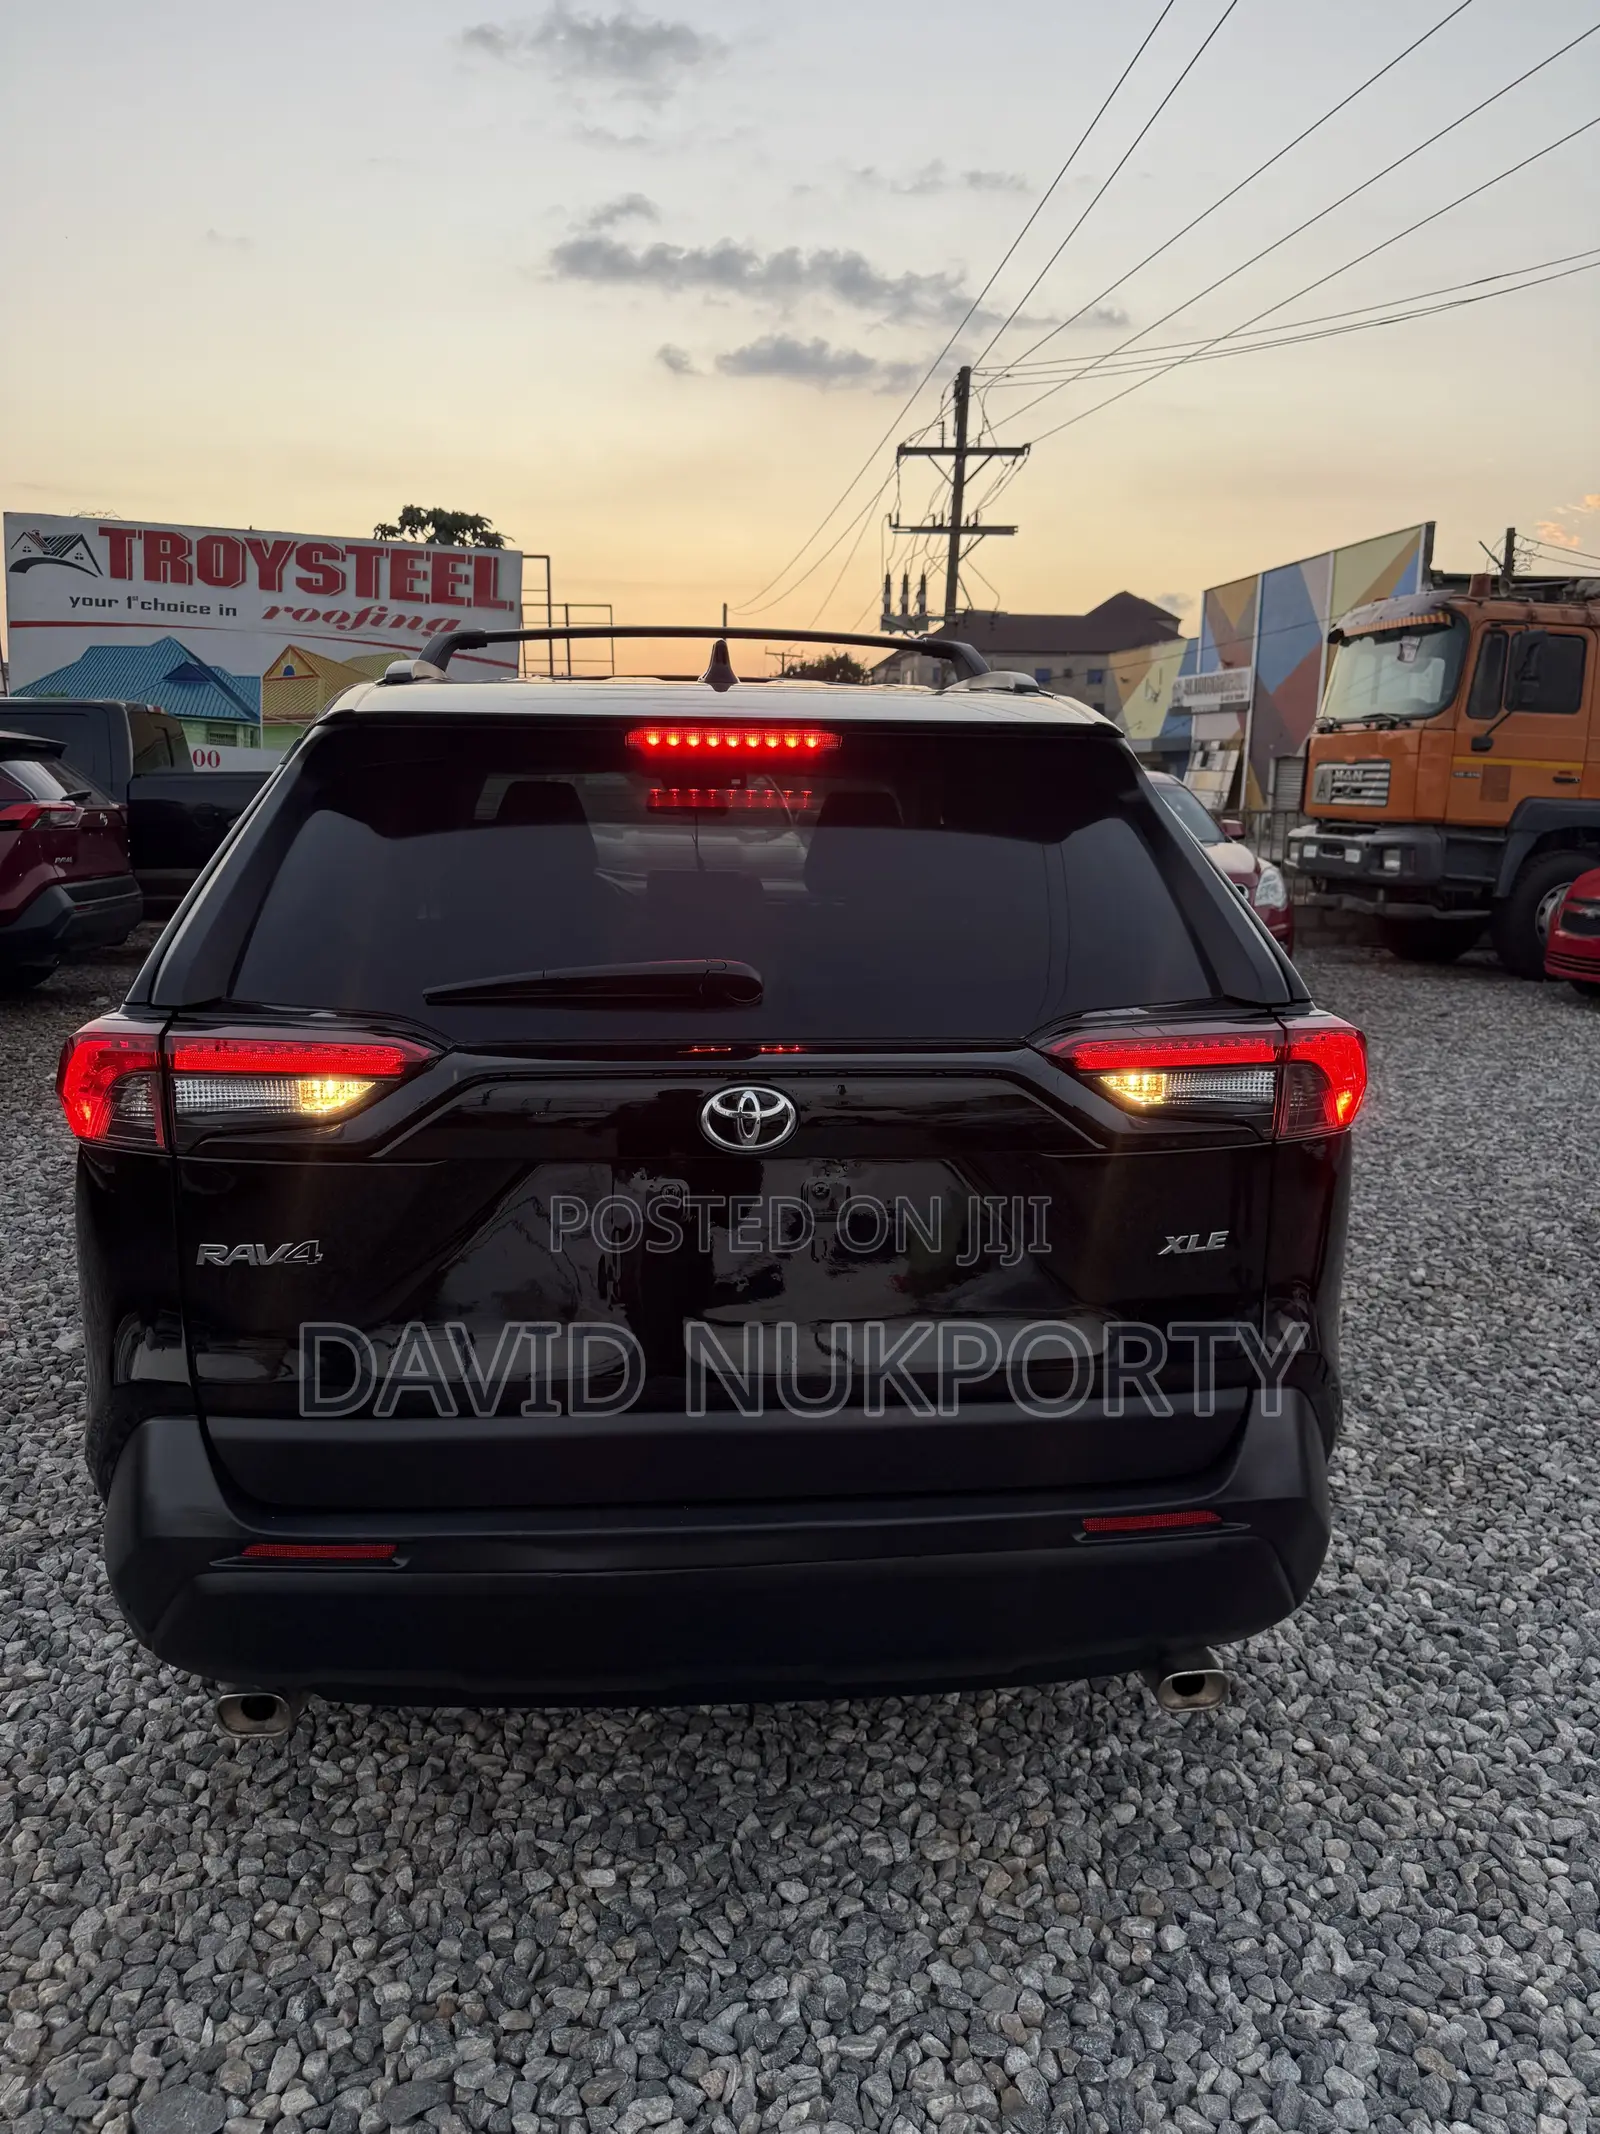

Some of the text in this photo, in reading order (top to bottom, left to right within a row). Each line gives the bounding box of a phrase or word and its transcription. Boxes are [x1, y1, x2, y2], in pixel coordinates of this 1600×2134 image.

[98, 527, 515, 612] TROYSTEEL
[69, 596, 119, 609] your
[140, 597, 211, 616] choice
[218, 603, 238, 617] in
[261, 604, 462, 638] roofing
[1334, 769, 1364, 782] MAN
[196, 1240, 323, 1266] RAV4
[1157, 1230, 1229, 1255] XLE
